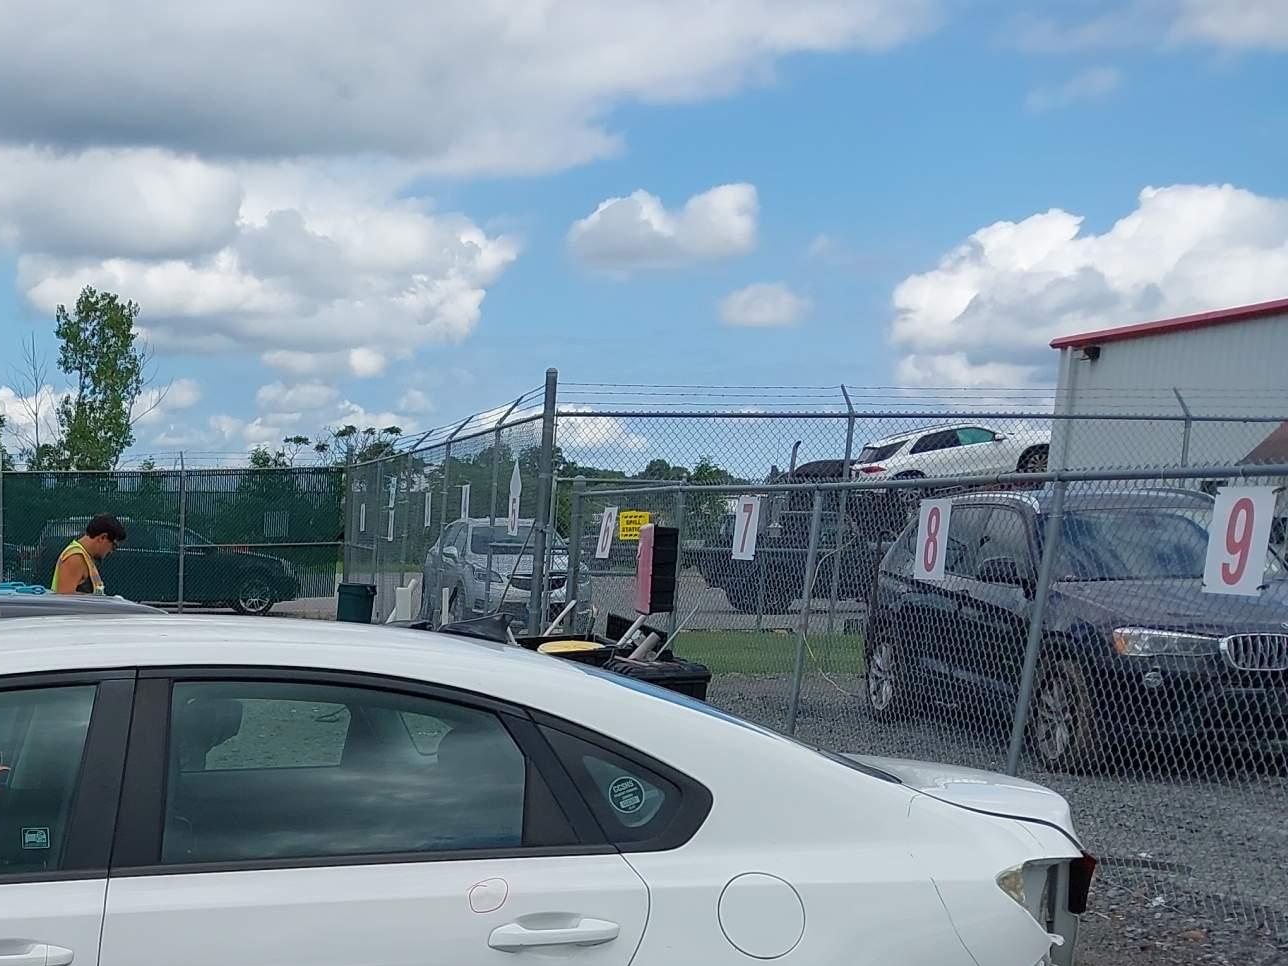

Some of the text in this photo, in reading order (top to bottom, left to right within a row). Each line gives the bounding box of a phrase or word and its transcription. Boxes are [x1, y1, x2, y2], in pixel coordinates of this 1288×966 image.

[600, 511, 613, 553] 6
[739, 503, 754, 553] 7
[923, 506, 941, 573] 8
[1221, 497, 1255, 586] 9
